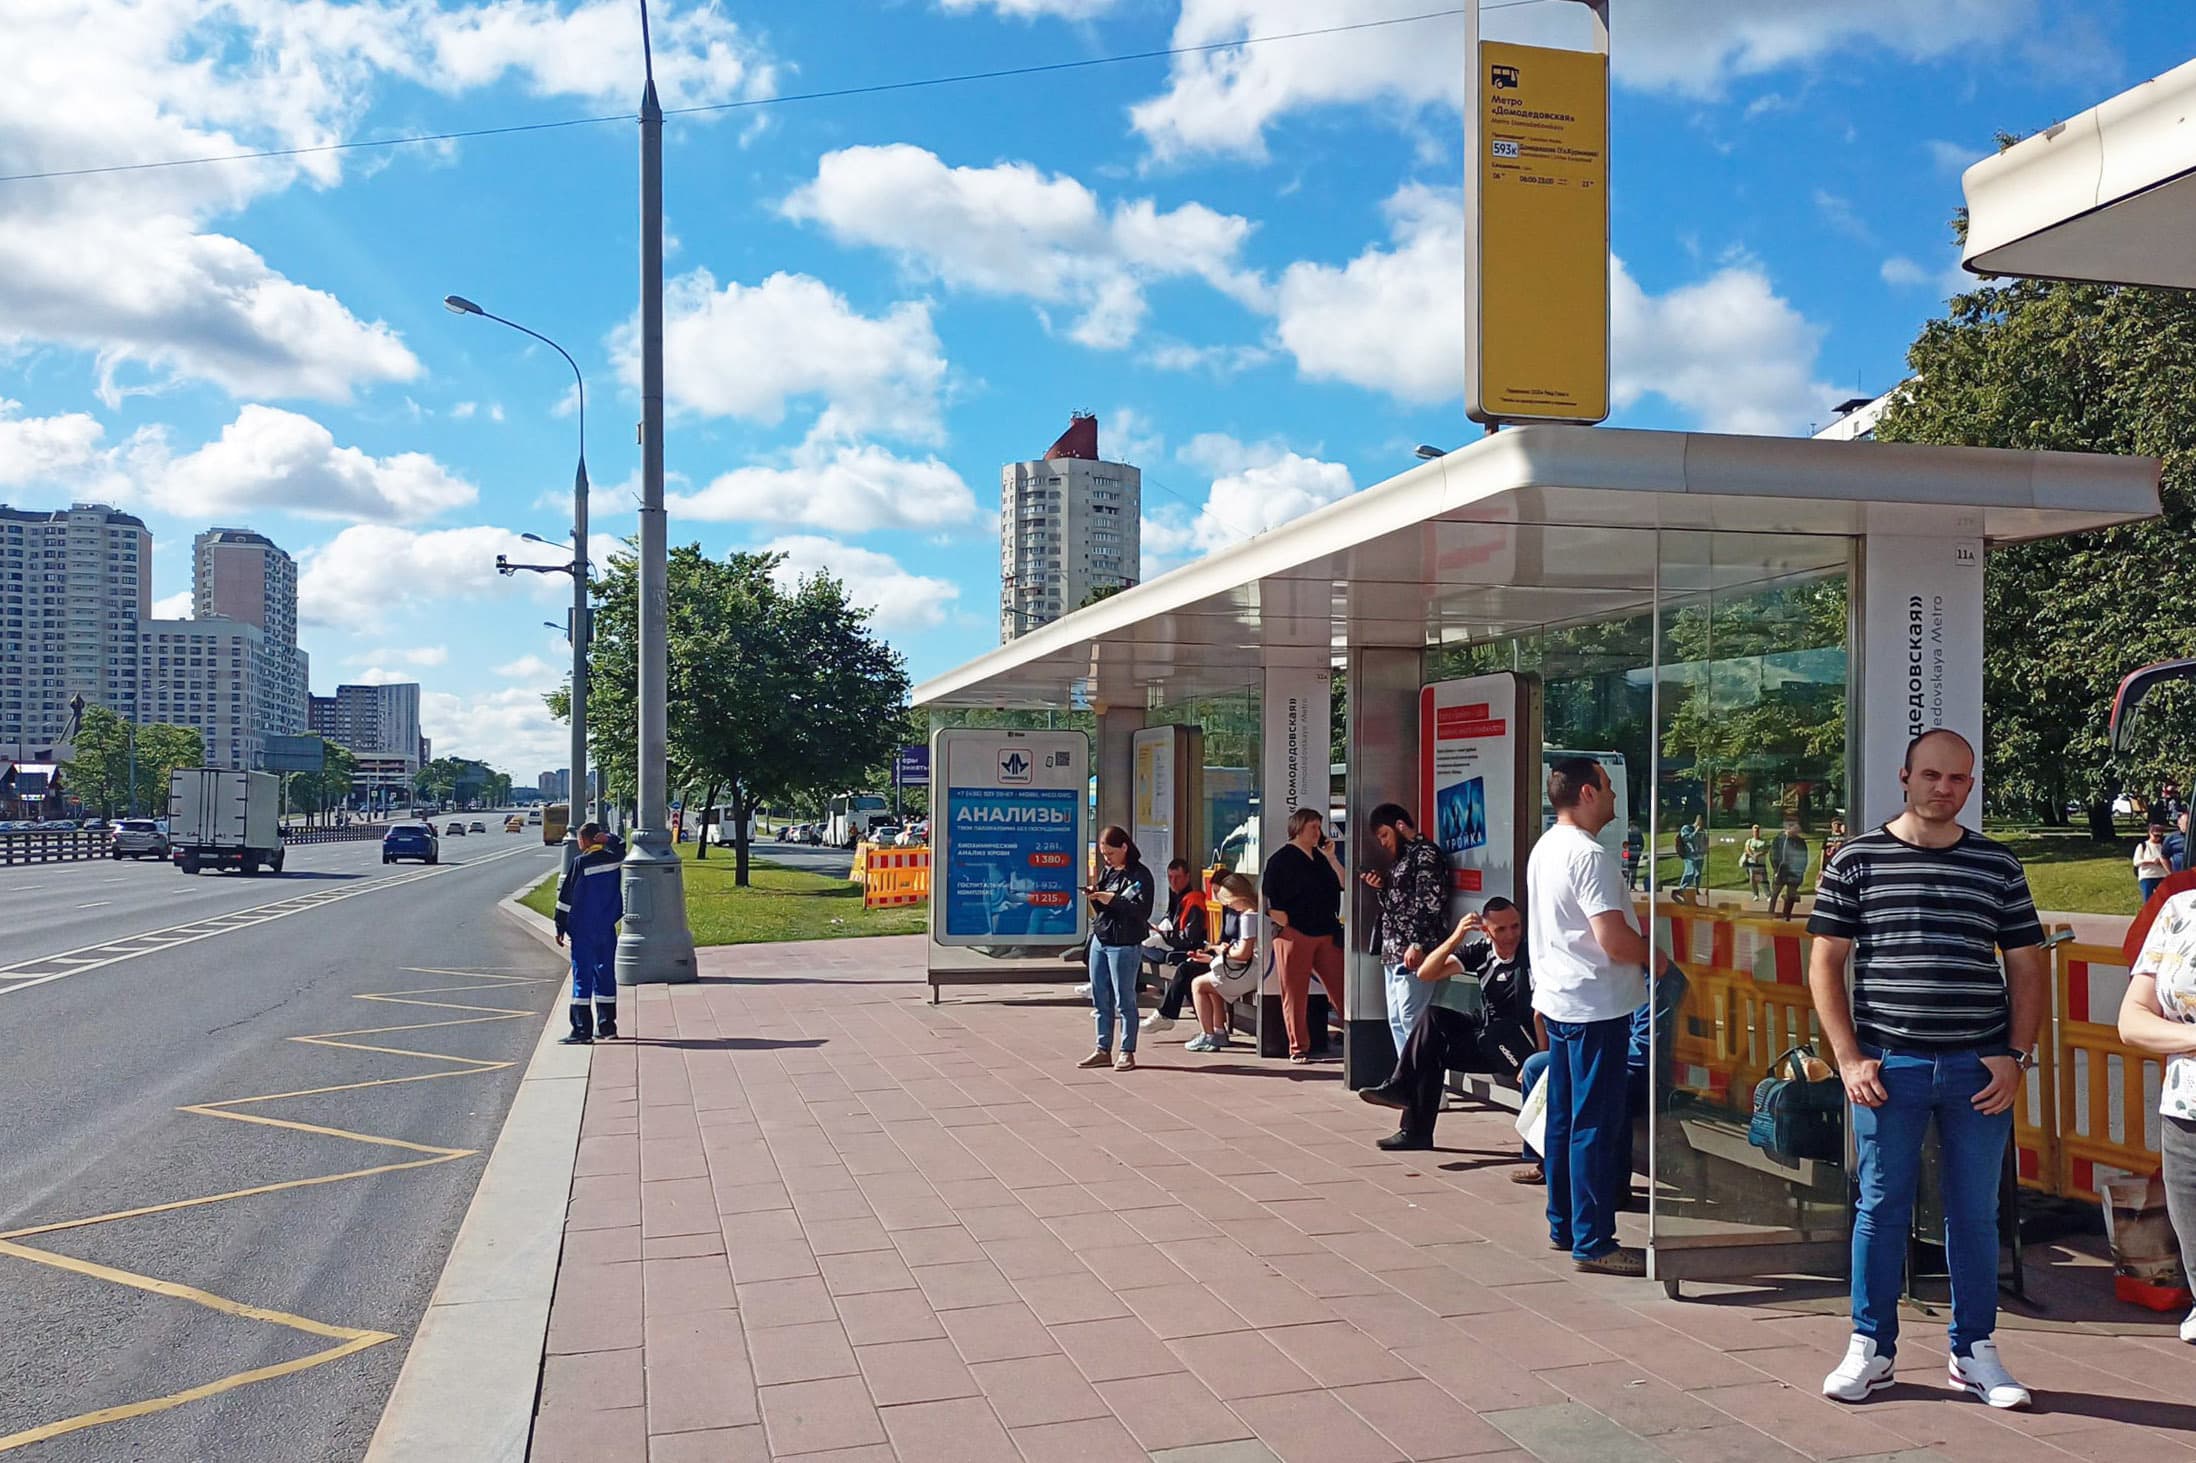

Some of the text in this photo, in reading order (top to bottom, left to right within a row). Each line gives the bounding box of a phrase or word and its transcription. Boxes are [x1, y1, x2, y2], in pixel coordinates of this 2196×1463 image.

[1491, 95, 1523, 106] Метро
[1491, 106, 1575, 121] «Домодедовская»
[1493, 142, 1517, 155] 593к
[1909, 595, 1925, 738] дедовская»
[1930, 595, 1945, 728] edovskaya Metro
[1286, 698, 1298, 813] «Домодедовская»
[1446, 831, 1482, 850] ТРОЙКА
[1498, 1044, 1519, 1067] adidas
